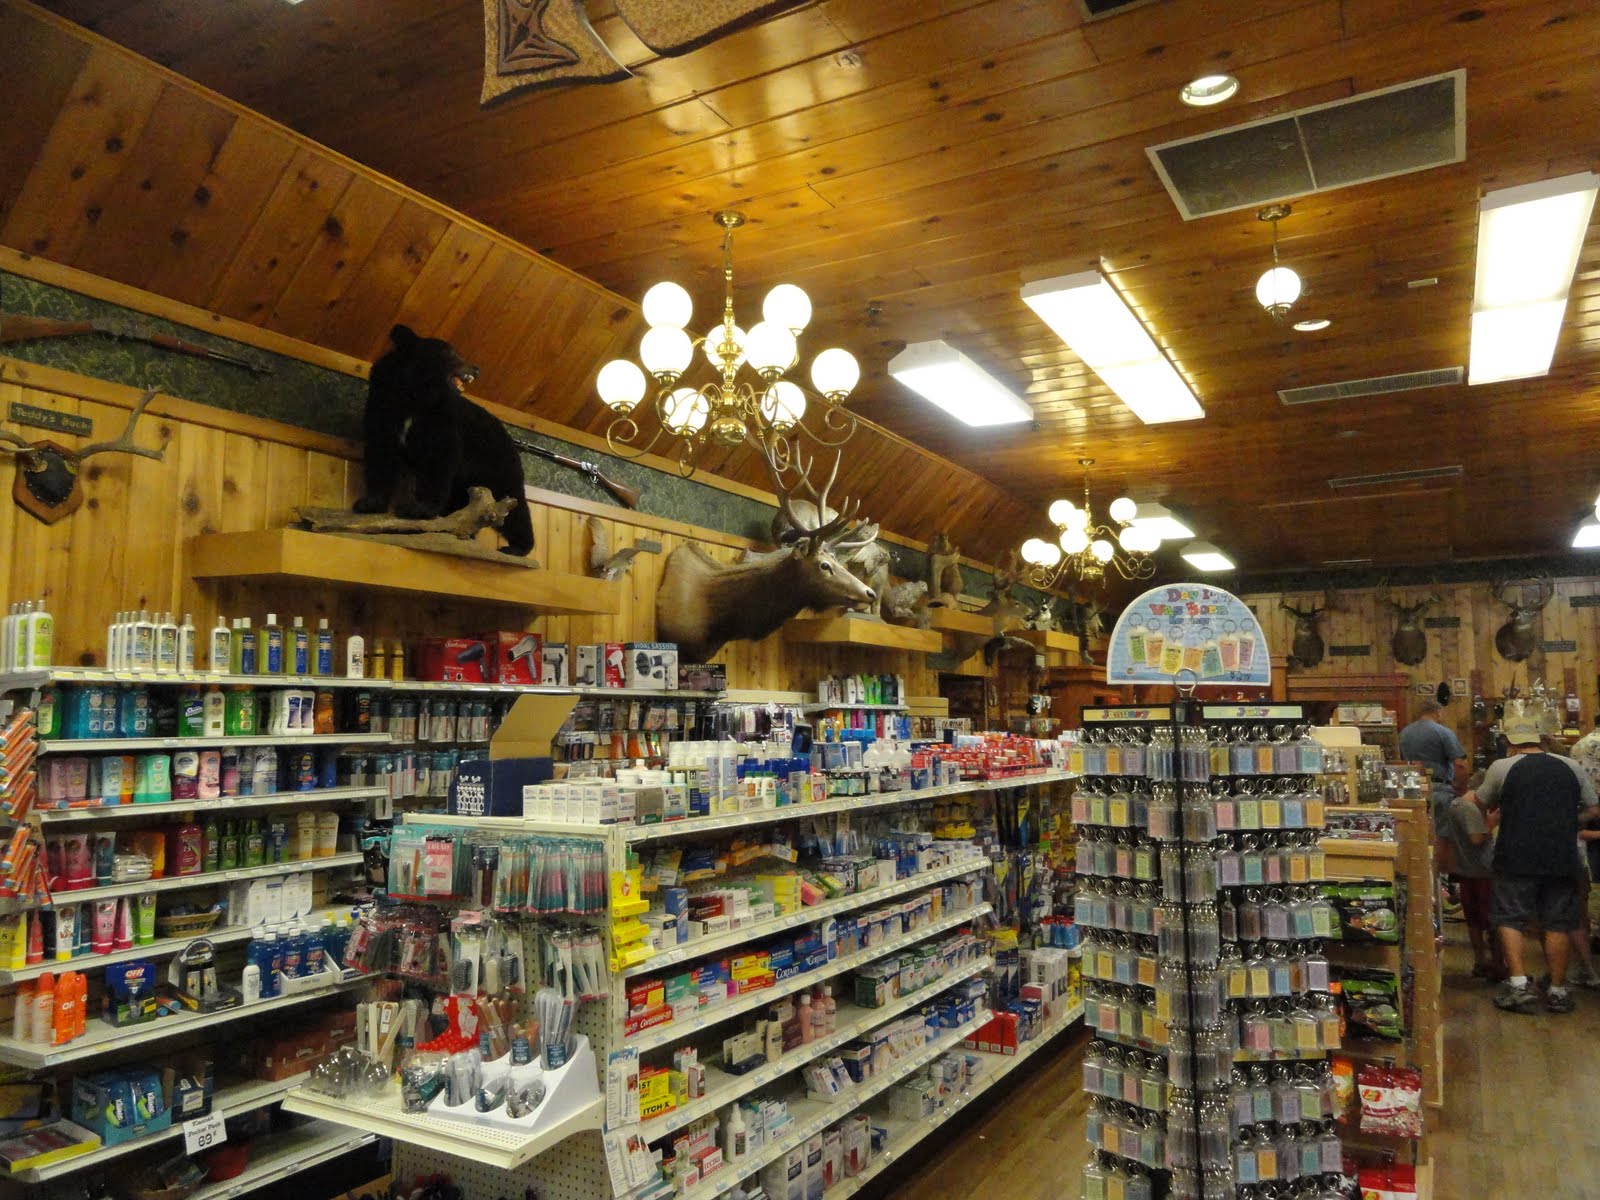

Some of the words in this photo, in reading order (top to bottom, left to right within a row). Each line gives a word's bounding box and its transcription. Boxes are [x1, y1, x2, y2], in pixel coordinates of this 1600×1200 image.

[1166, 588, 1199, 602] Day
[1148, 603, 1184, 616] Was
[1186, 601, 1229, 616] Born
[634, 642, 651, 650] VIDAL
[1101, 709, 1149, 720] January
[1236, 707, 1270, 717] July
[125, 968, 145, 978] OFF!
